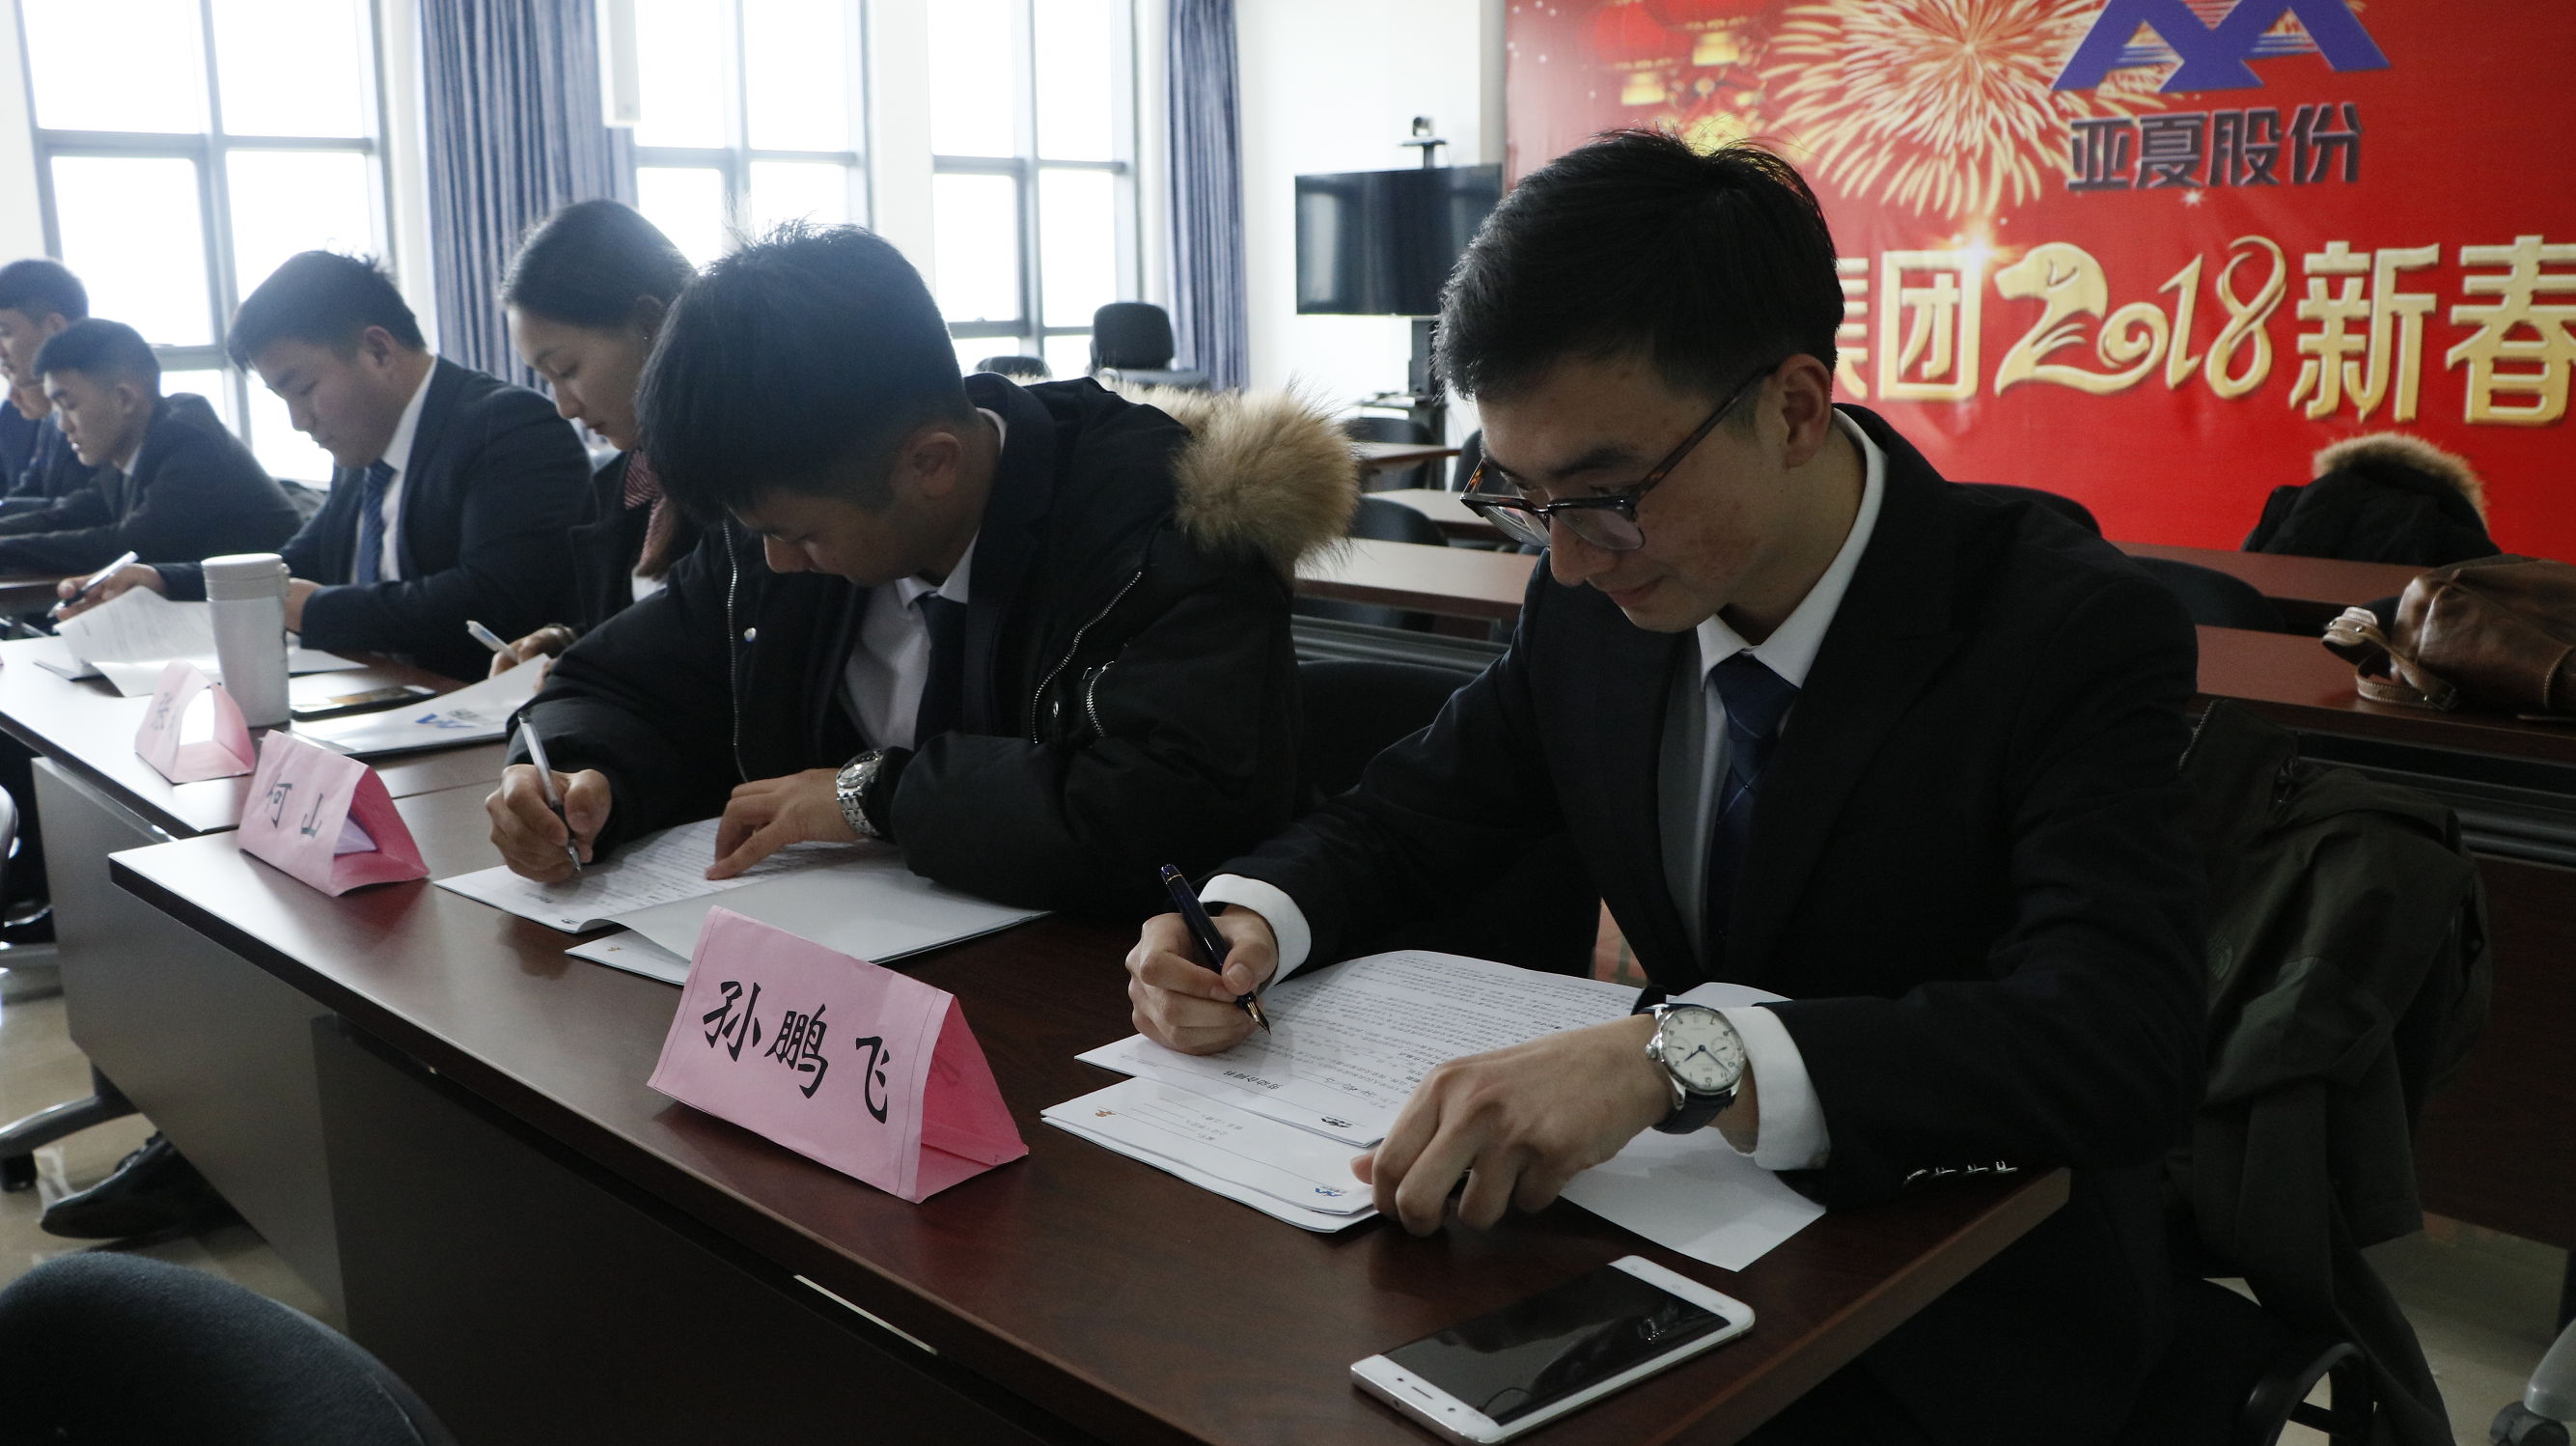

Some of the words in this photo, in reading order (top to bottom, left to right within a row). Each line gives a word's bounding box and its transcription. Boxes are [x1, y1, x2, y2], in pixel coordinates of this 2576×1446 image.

[2067, 102, 2363, 191] 亚夏股份
[702, 980, 891, 1126] 孙鹏飞
